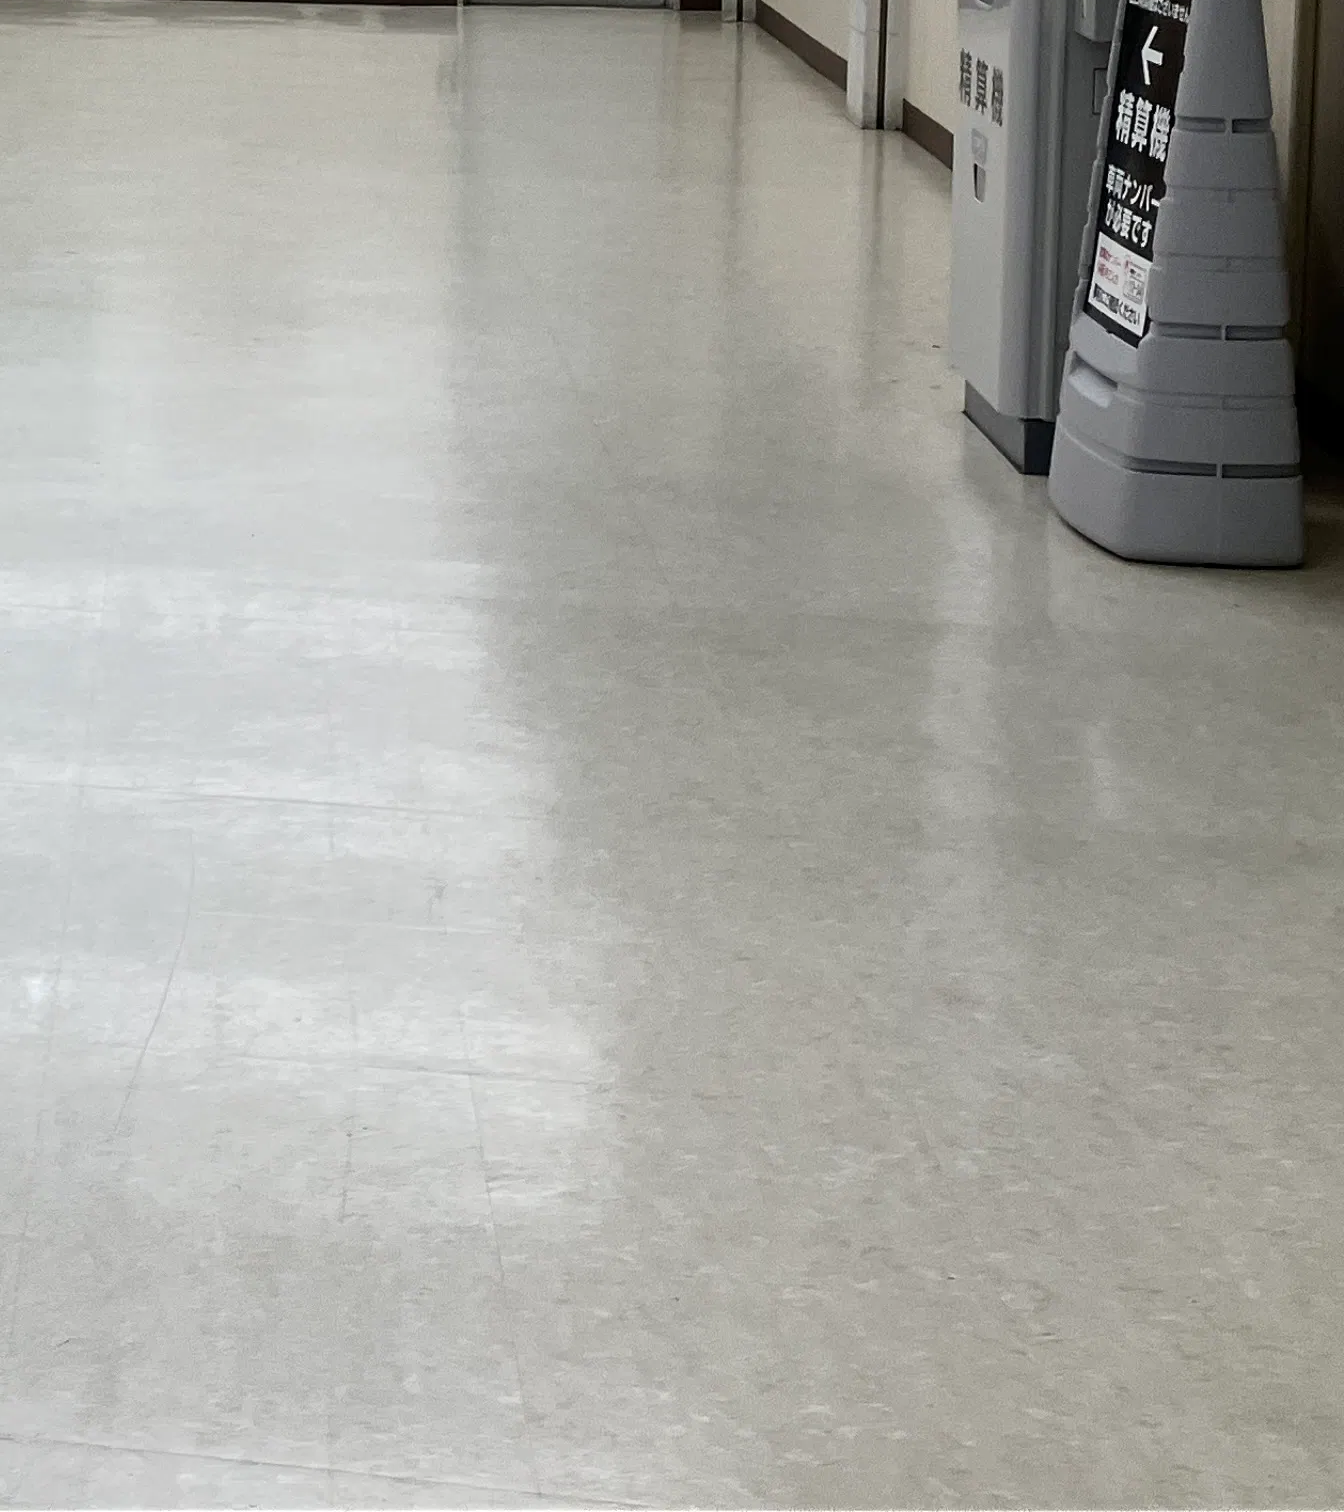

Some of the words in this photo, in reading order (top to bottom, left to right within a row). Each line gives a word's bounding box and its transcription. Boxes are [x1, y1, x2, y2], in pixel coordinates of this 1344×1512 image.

[959, 48, 1004, 127] 精算機
[1116, 89, 1171, 162] 精算機
[1106, 163, 1160, 212] 車両ナンバー
[1105, 199, 1152, 248] が必要です
